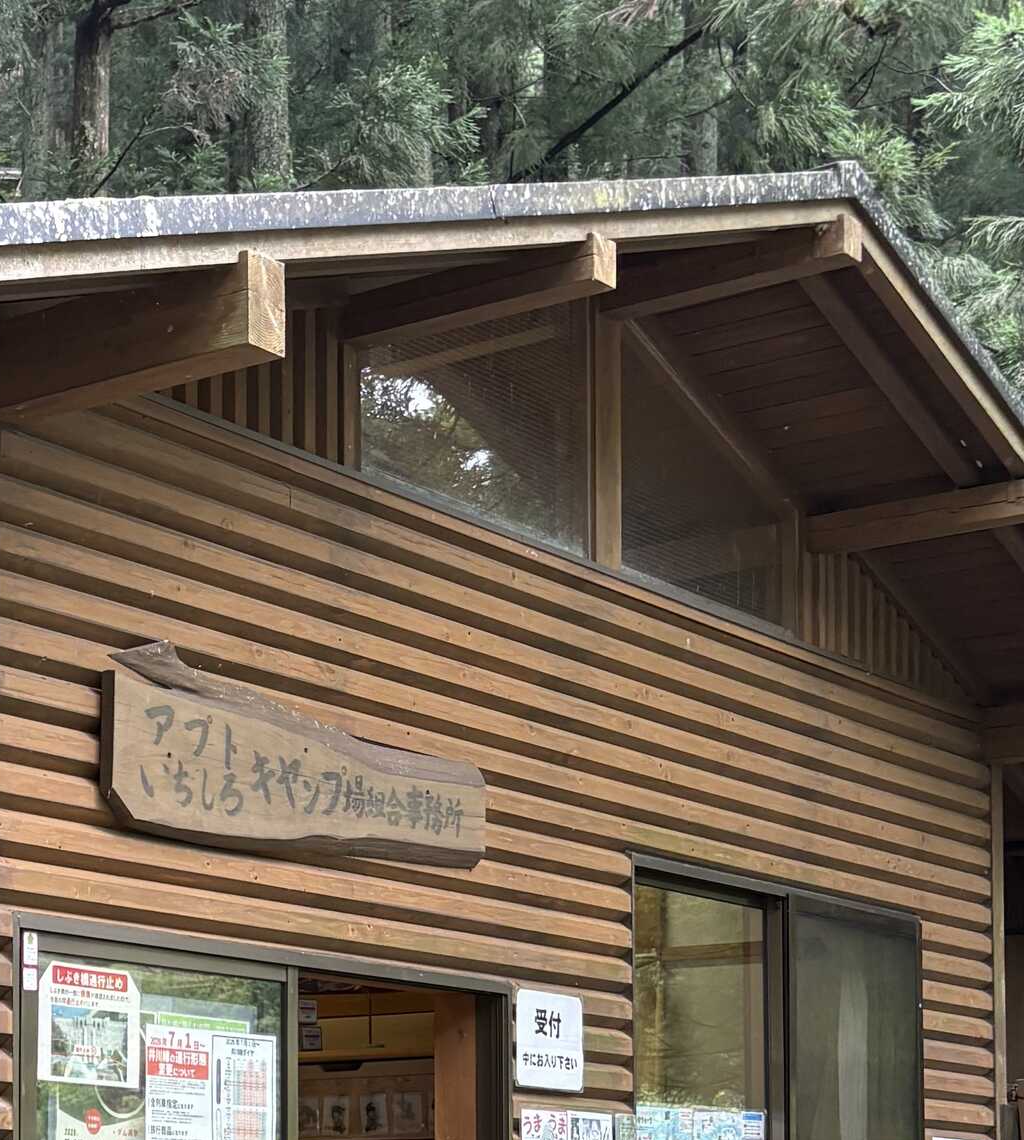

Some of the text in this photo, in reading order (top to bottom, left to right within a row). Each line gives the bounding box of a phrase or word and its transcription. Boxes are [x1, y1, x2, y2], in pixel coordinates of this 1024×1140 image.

[144, 705, 241, 769] アプト
[534, 1008, 562, 1039] 受付
[522, 1053, 578, 1071] 中にお入り下さい
